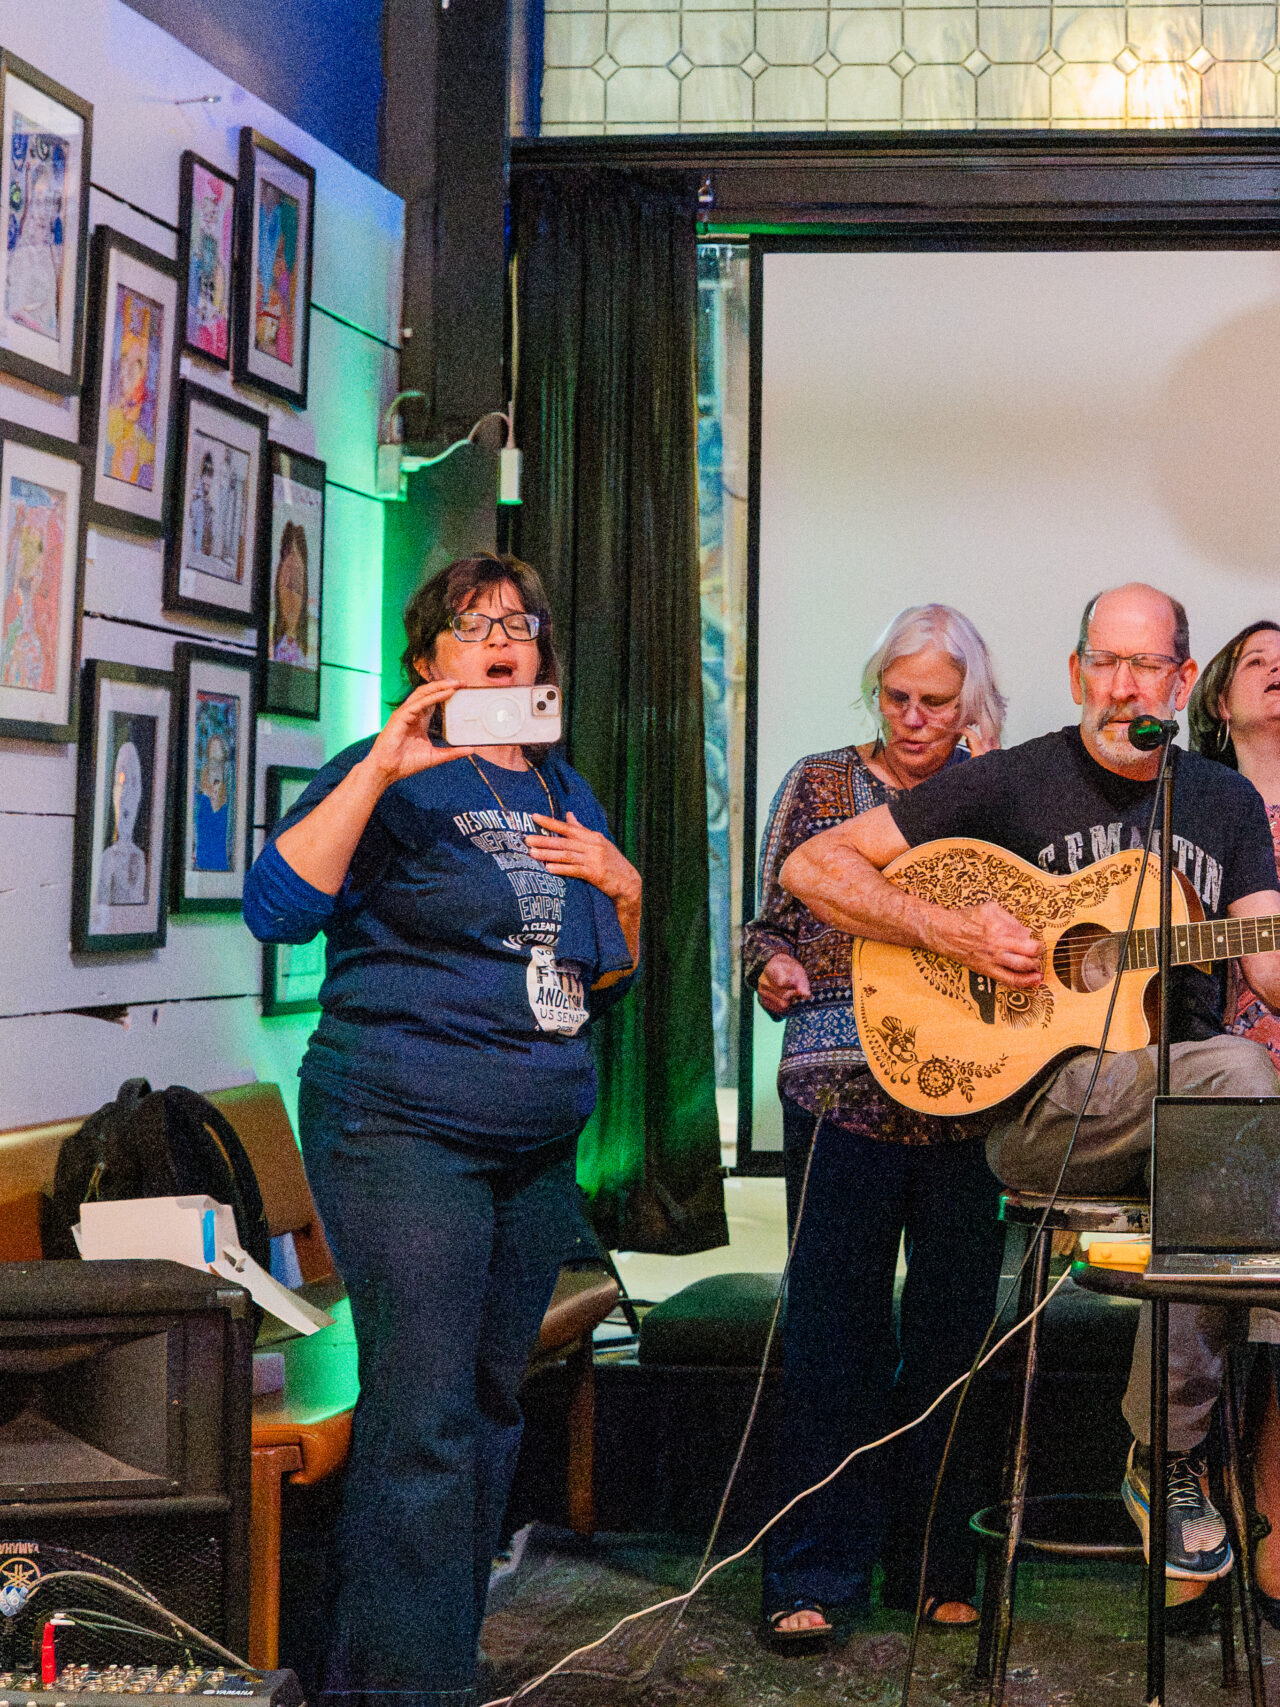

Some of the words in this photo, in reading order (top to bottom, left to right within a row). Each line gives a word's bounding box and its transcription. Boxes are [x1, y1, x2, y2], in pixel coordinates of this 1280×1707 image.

[453, 810, 506, 836] RESTORE
[518, 896, 565, 921] EMPA
[531, 922, 555, 932] CLEAR
[540, 1008, 554, 1020] US
